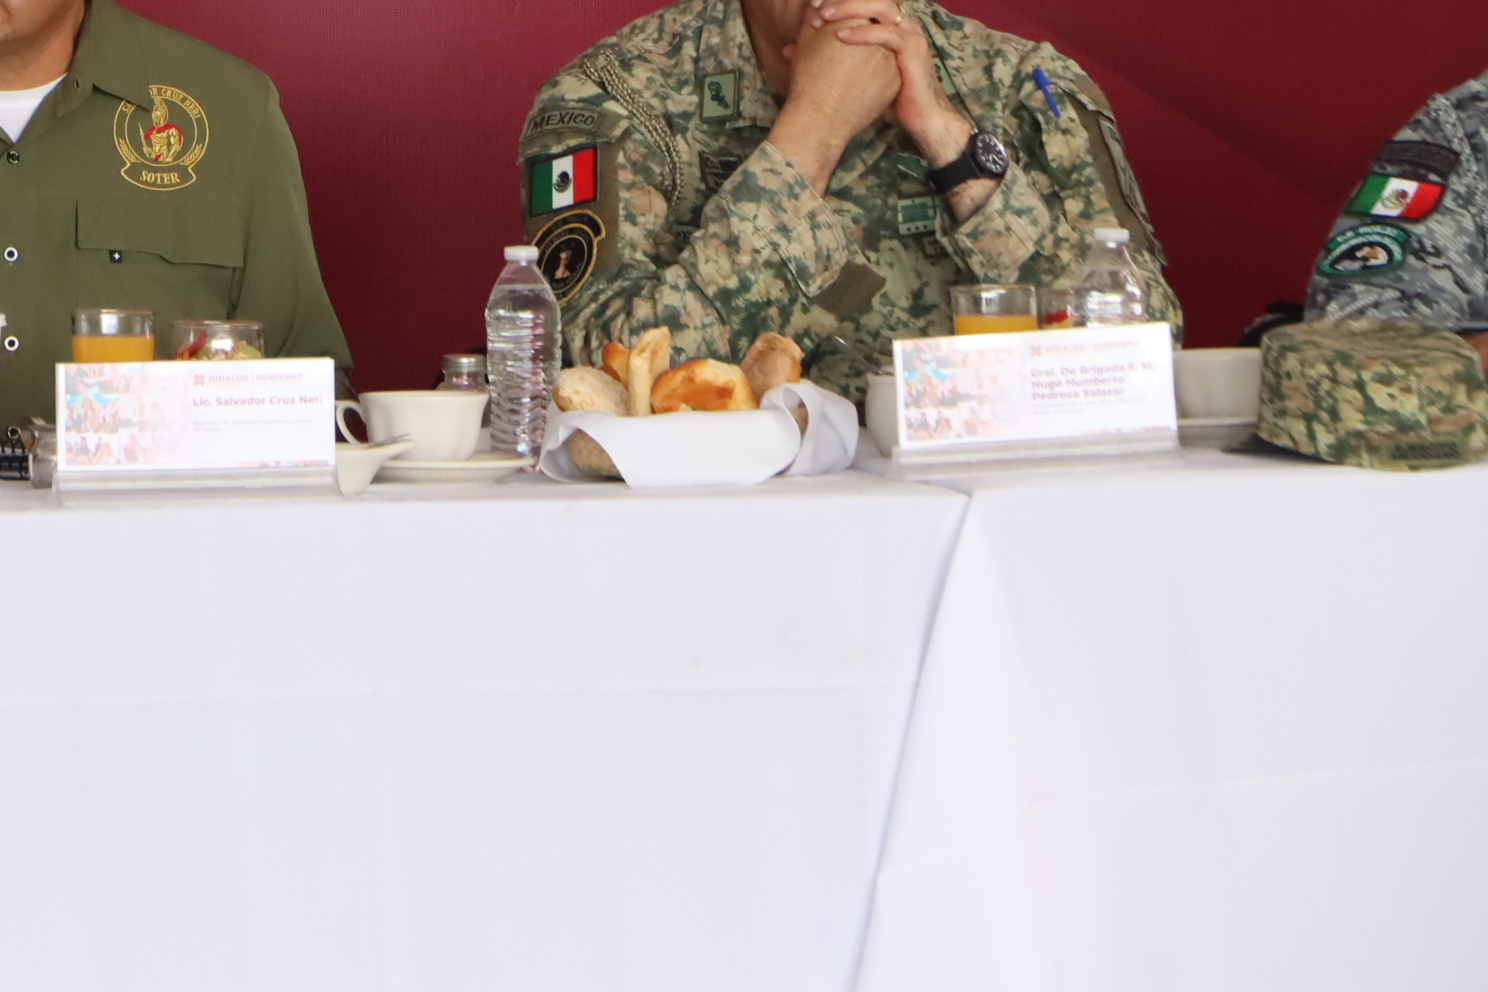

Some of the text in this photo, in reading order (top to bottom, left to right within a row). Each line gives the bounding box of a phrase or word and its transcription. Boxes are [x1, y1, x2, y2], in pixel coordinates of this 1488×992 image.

[161, 88, 184, 103] CRUZ
[183, 100, 202, 119] NERI
[140, 170, 180, 185] SOTER
[208, 373, 303, 382] HIDALGO GOBIERNO
[193, 395, 324, 407] Lic. Salvador Cruz Neri
